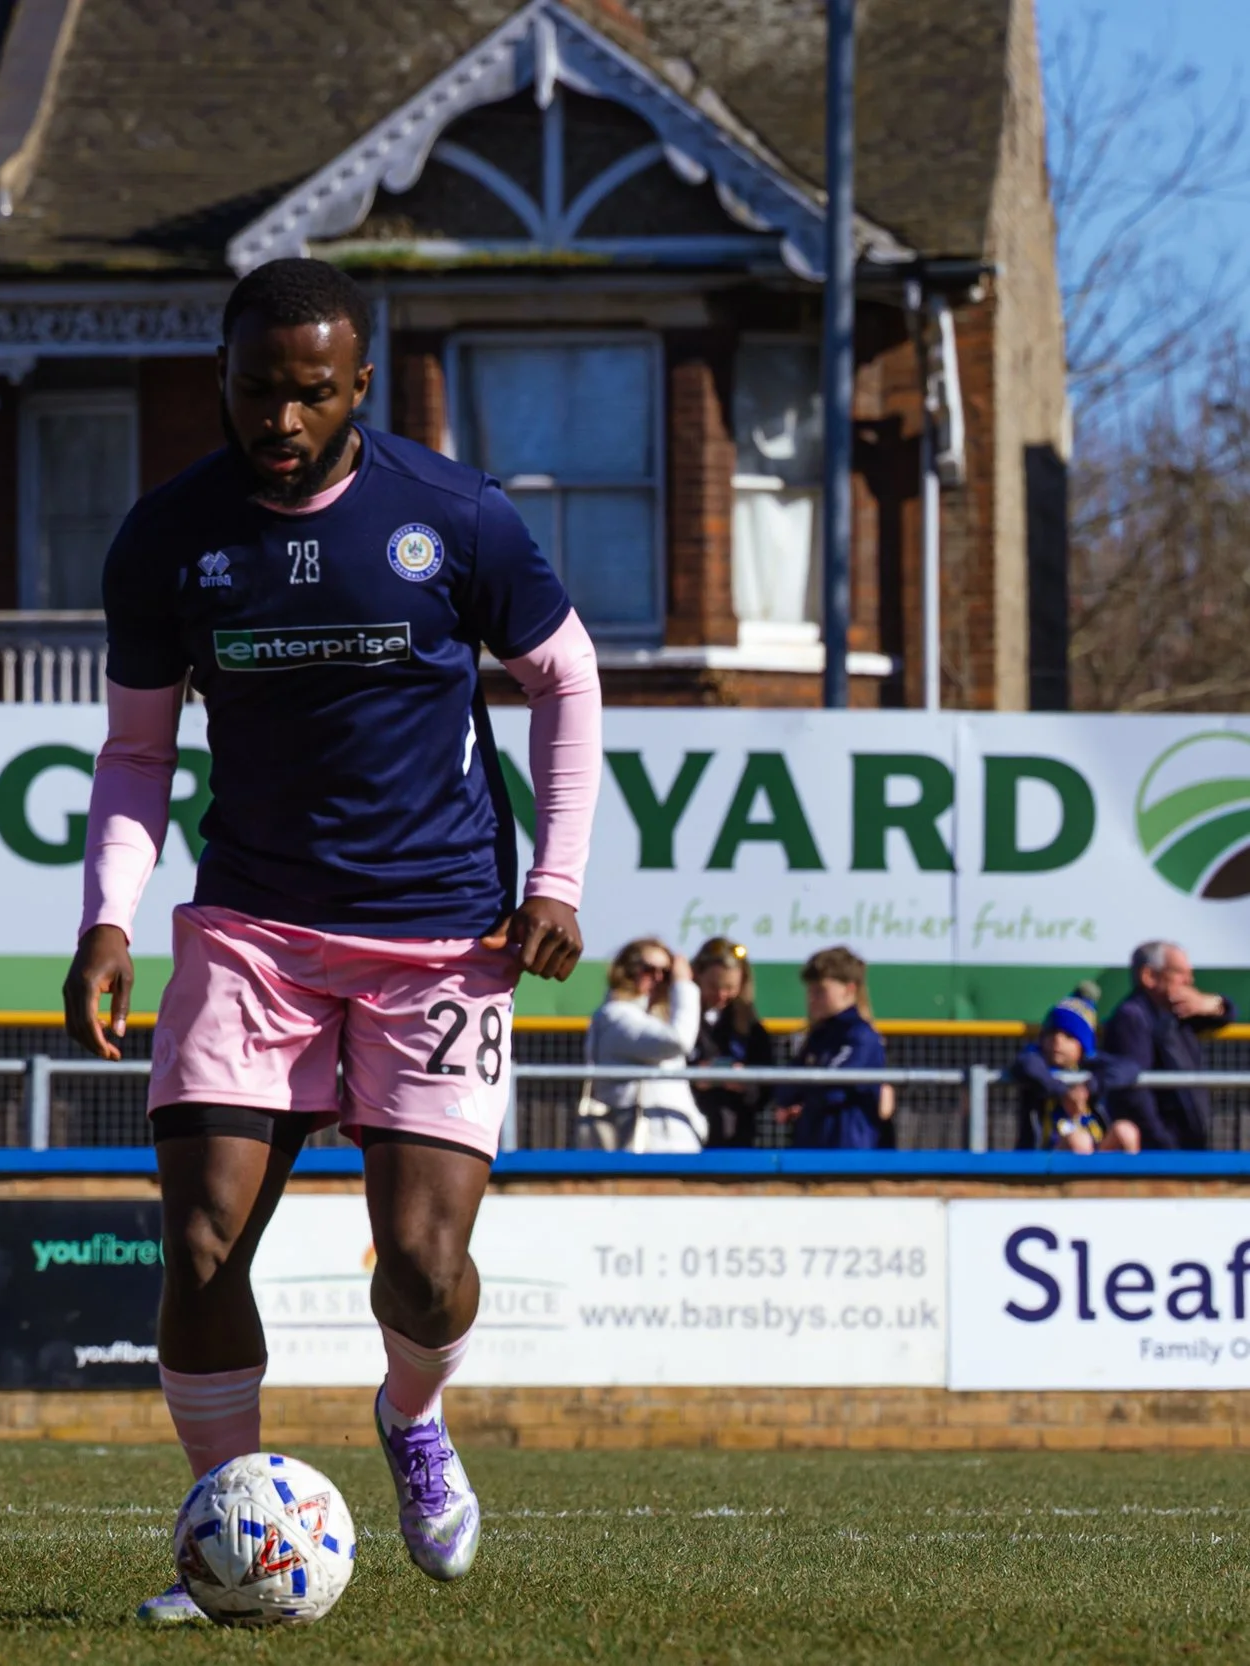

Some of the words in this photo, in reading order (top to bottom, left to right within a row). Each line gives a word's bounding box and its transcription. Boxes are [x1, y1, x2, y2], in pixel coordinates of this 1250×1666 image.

[287, 540, 320, 584] 28
[226, 633, 406, 660] enterprise
[679, 900, 739, 942] for
[753, 917, 773, 938] a
[790, 900, 956, 940] healthier
[971, 901, 1097, 949] future
[426, 1000, 502, 1085] 28
[32, 1233, 158, 1272] youfibre
[594, 1247, 643, 1277] Tel
[680, 1246, 787, 1278] 01553
[800, 1246, 928, 1278] 772348
[1004, 1226, 1250, 1322] Sleaf
[579, 1299, 940, 1337] www.barsbys.co.uk
[1139, 1336, 1223, 1366] Family
